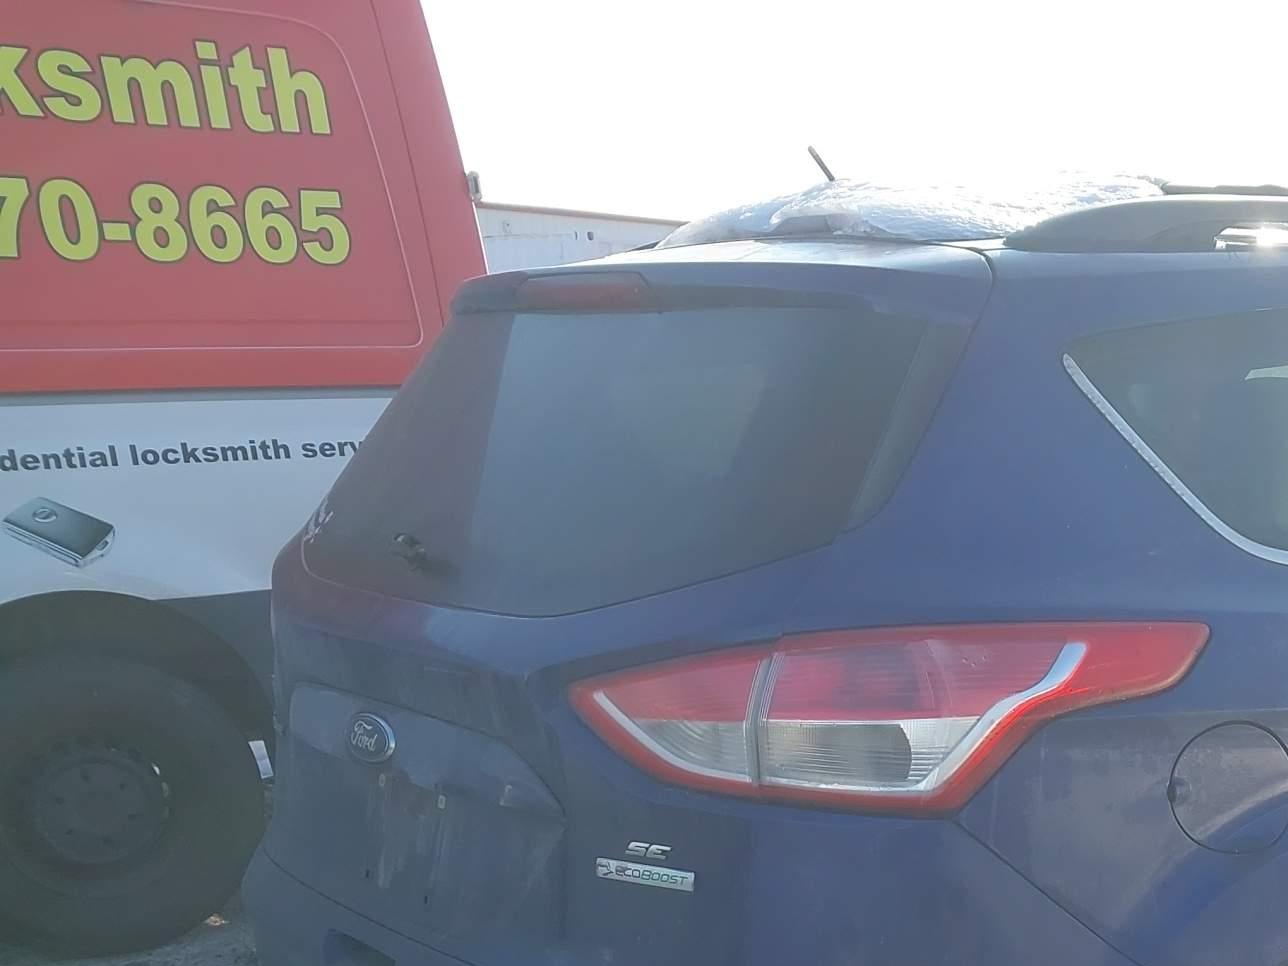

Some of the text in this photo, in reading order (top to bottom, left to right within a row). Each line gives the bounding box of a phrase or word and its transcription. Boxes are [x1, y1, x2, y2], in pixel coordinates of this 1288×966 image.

[129, 438, 291, 466] locksmith
[351, 720, 378, 752] Ford
[625, 841, 671, 860] SE
